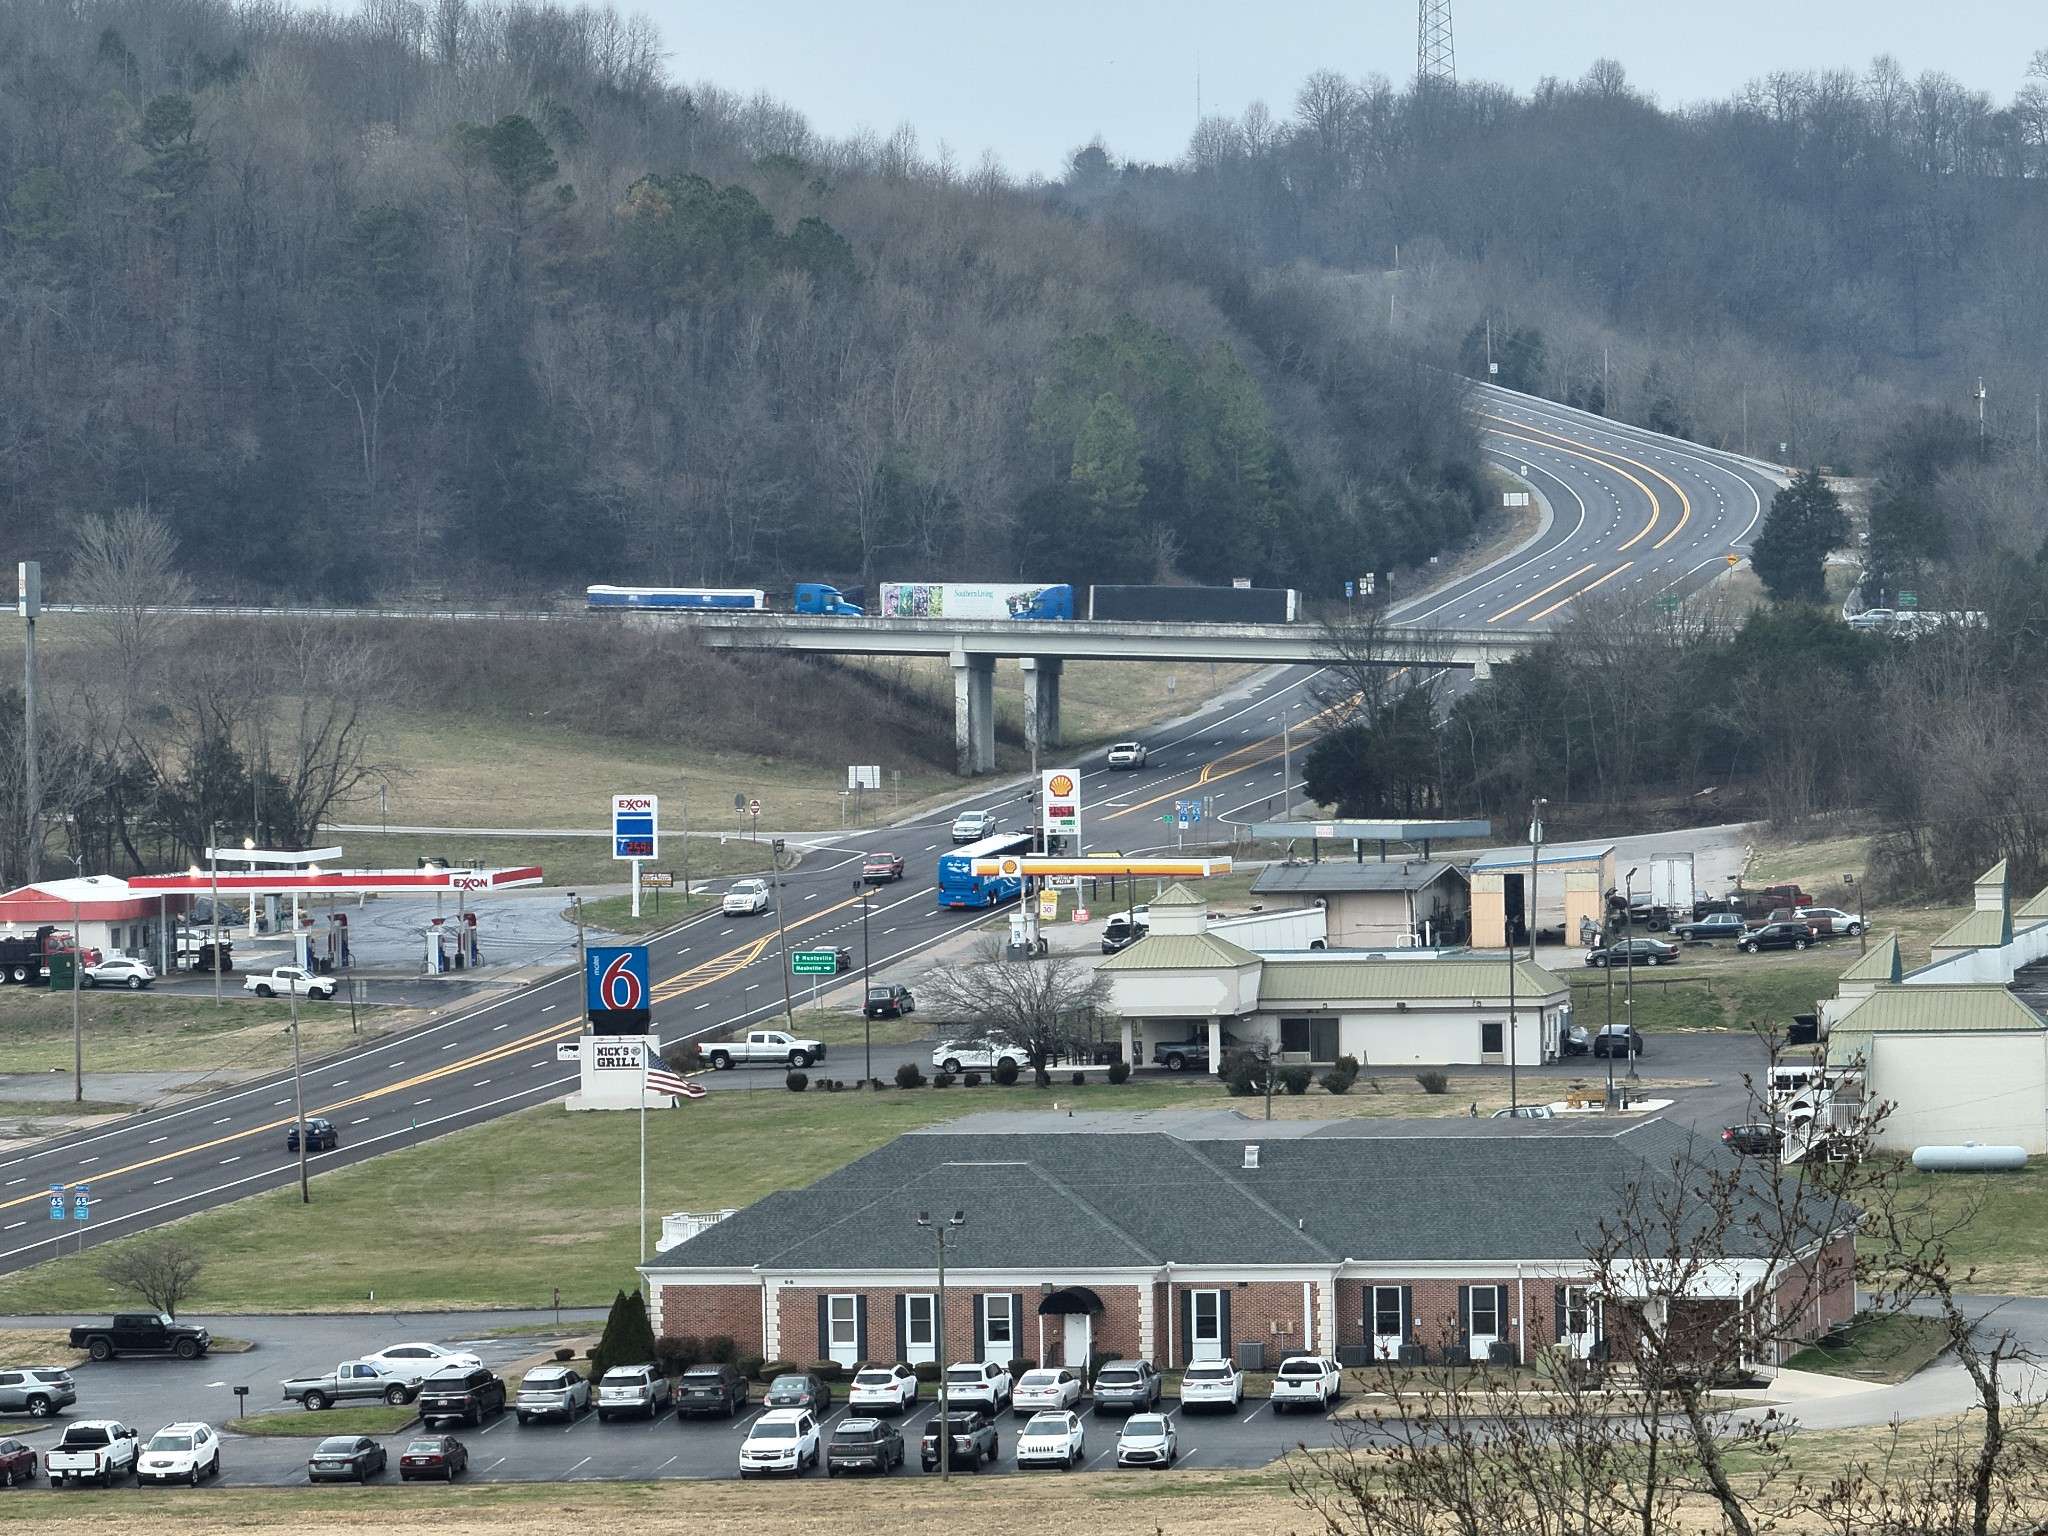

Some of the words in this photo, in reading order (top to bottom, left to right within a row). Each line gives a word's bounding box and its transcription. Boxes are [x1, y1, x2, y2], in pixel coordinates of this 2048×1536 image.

[618, 799, 651, 811] EXXON
[453, 877, 488, 891] EXXON
[600, 952, 641, 1010] 6
[596, 1045, 629, 1056] NICK'S
[597, 1057, 640, 1067] GRILL
[51, 1197, 63, 1206] 65
[76, 1197, 87, 1206] 65
